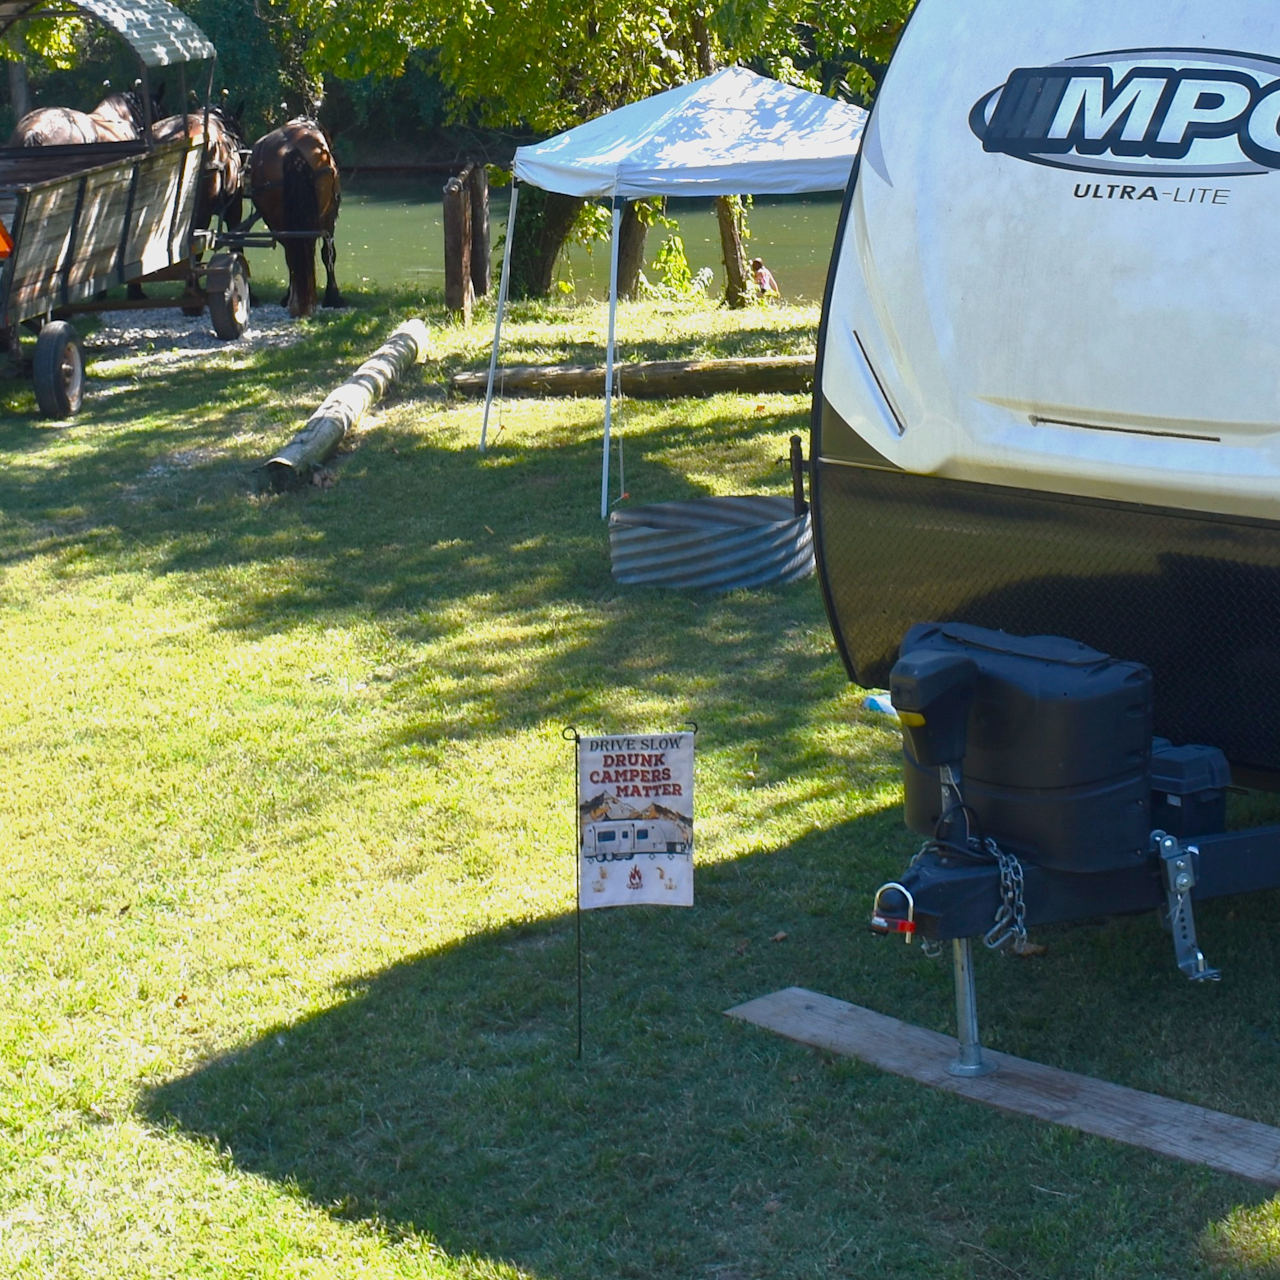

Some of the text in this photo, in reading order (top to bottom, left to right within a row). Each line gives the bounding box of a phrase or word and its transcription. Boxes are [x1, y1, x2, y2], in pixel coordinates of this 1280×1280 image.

[1073, 183, 1232, 205] ULTRA-LITE
[589, 735, 683, 752] DRIVE SLOW
[602, 753, 666, 768] DRUNK
[589, 768, 672, 785] CAMPERS
[615, 783, 683, 798] MATTER
